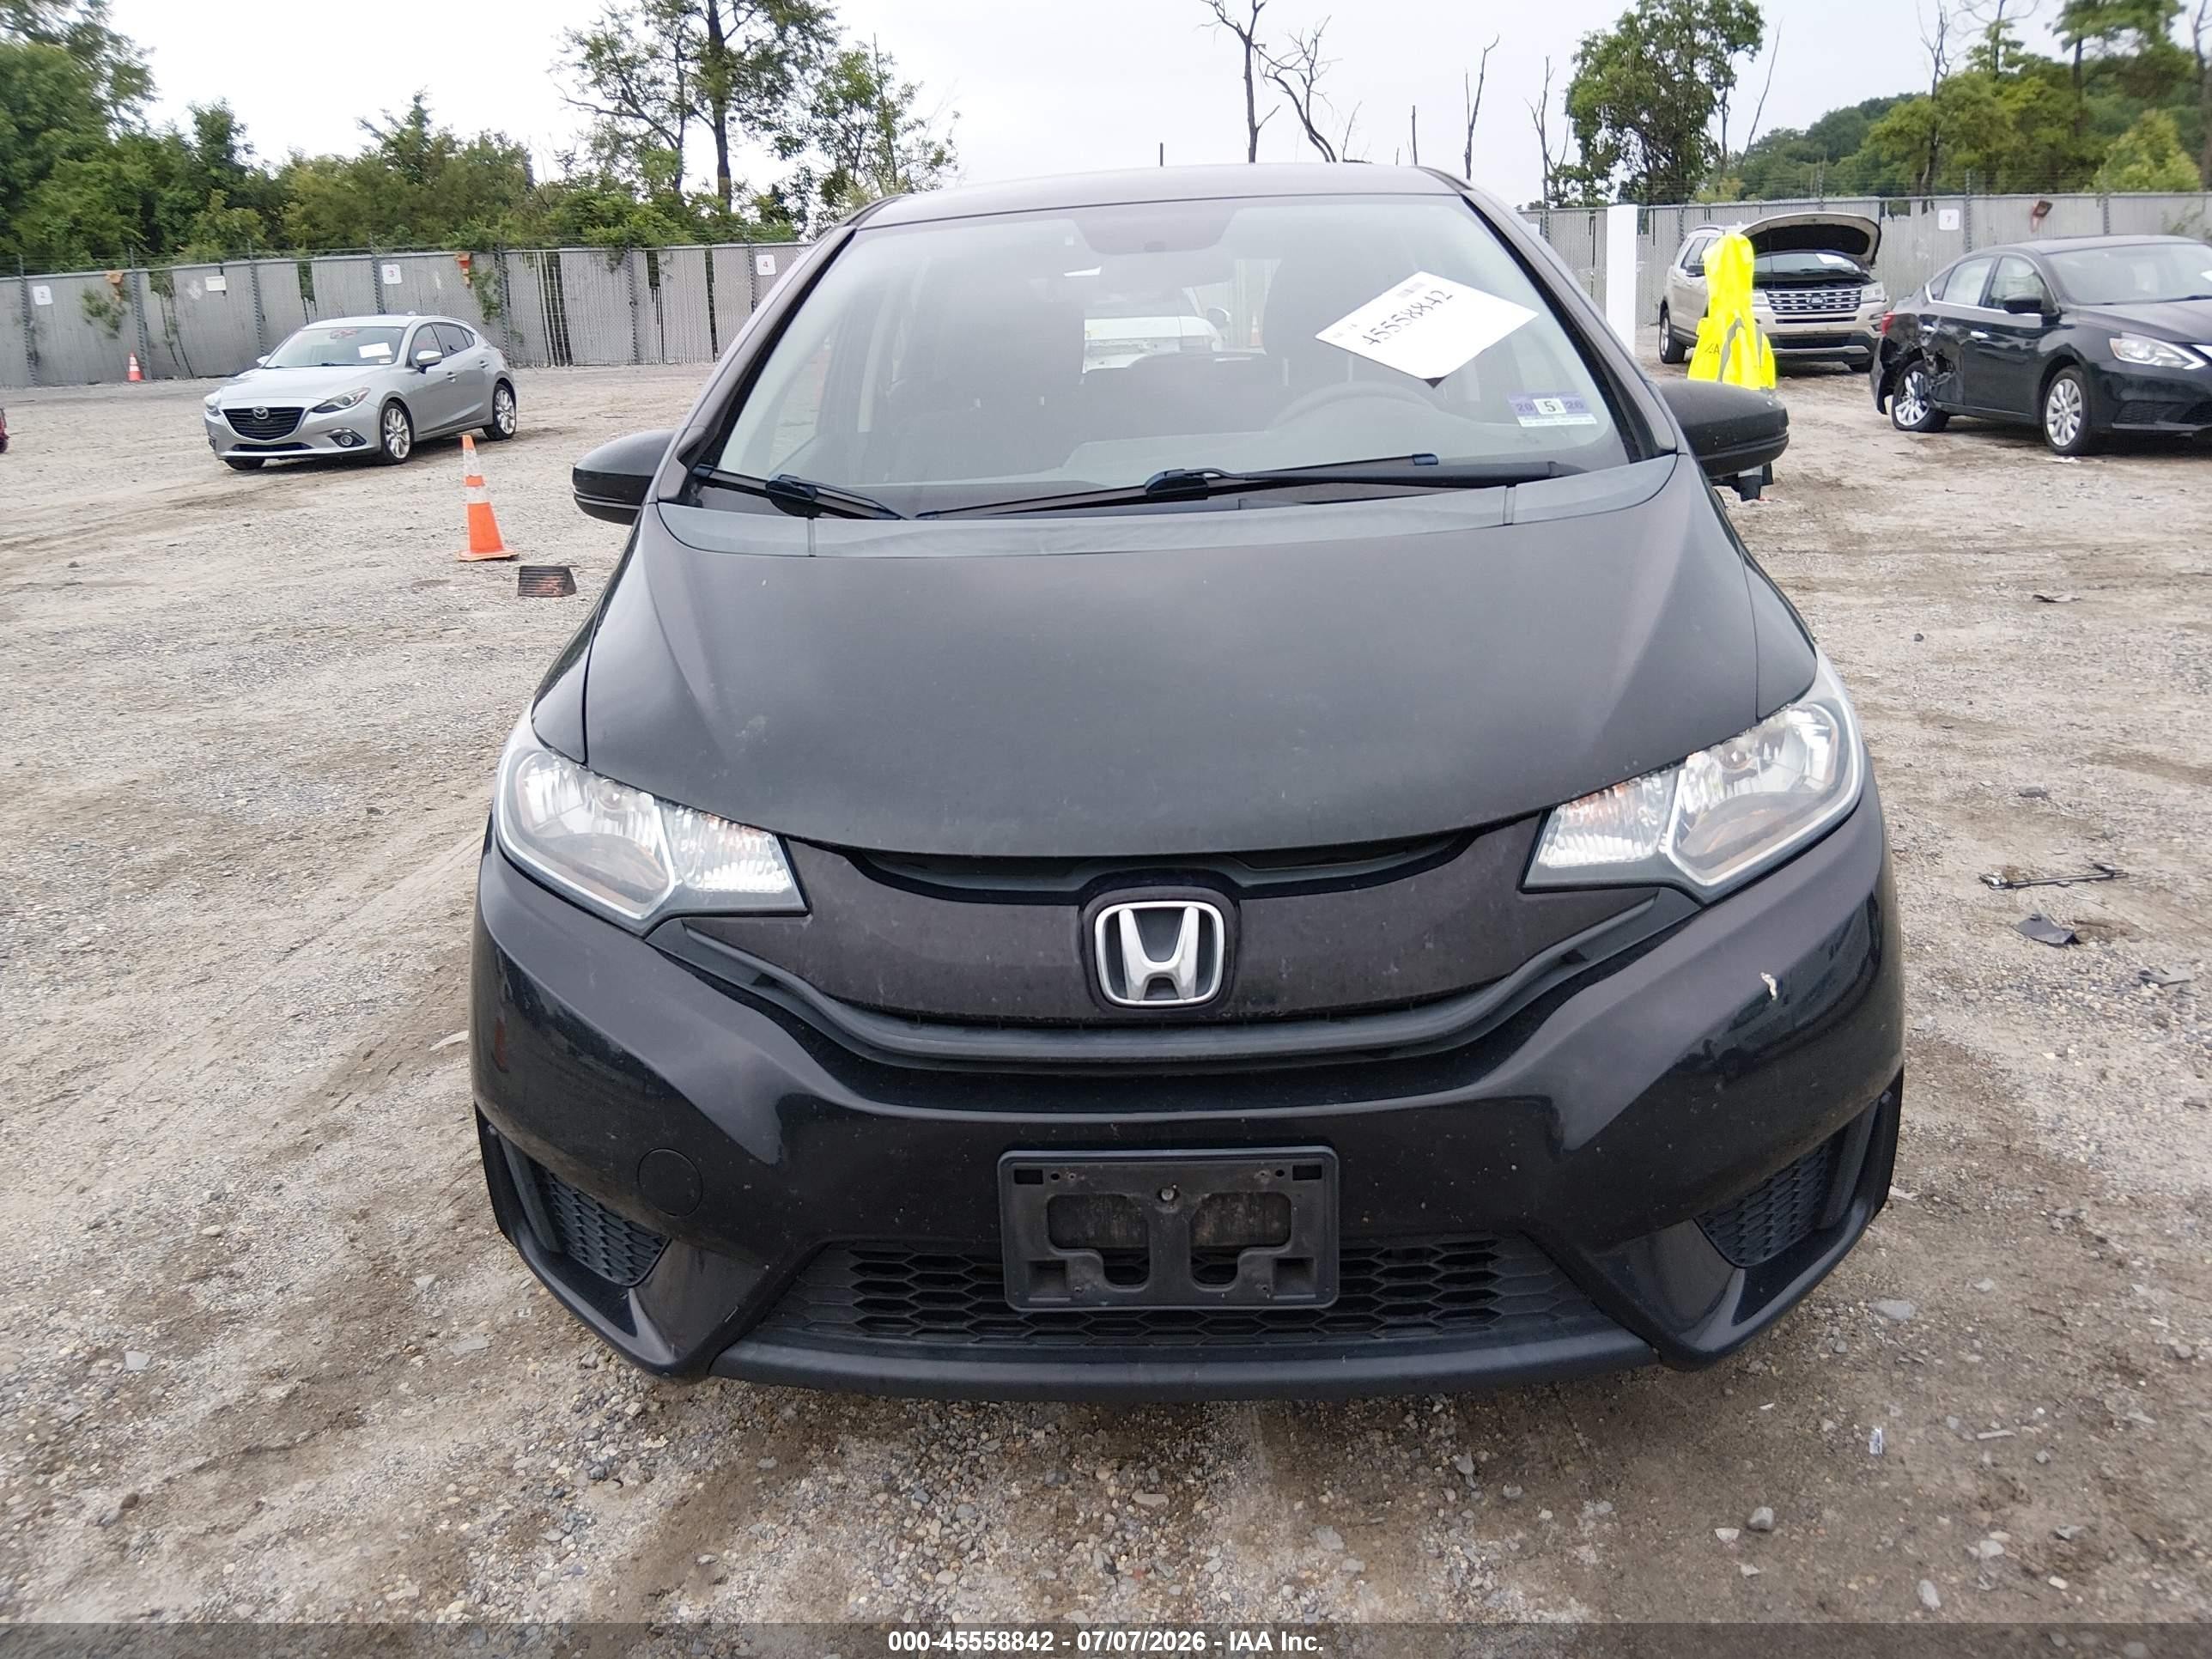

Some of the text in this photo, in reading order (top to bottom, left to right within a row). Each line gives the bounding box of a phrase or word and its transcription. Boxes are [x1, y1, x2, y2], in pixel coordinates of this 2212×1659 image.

[1361, 289, 1454, 346] 45558842
[1516, 403, 1533, 412] 20
[1543, 400, 1557, 412] 5
